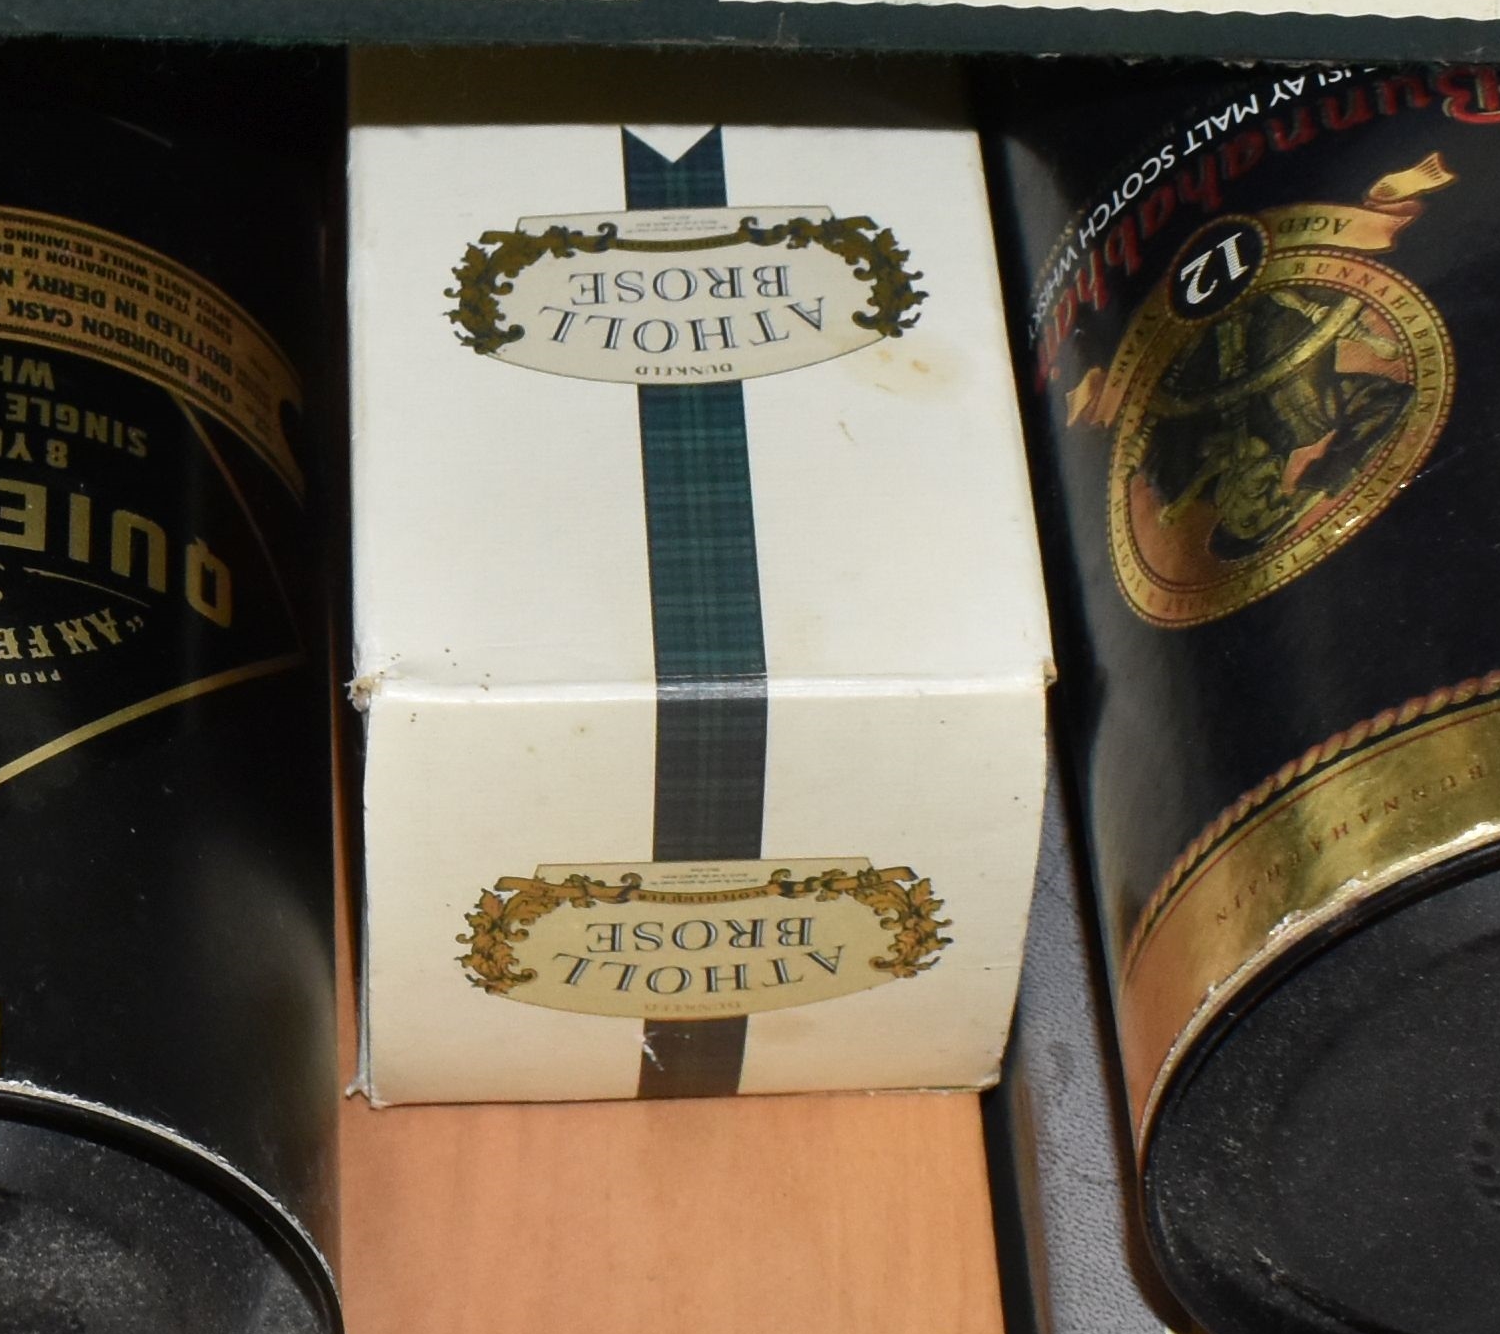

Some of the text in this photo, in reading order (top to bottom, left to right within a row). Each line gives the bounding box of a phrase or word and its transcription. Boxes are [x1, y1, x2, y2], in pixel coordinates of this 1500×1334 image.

[1182, 92, 1261, 156] MALT
[1077, 142, 1177, 247] SCOTCH
[1276, 215, 1353, 237] AGED
[22, 269, 108, 311] DERRY,
[565, 264, 790, 306] BROSE
[1177, 230, 1250, 306] 12
[7, 297, 74, 329] CASK
[113, 296, 139, 323] IN
[537, 296, 826, 355] ATHOLL
[81, 314, 191, 379] BOURBON
[145, 311, 235, 378] BOTTLED
[4, 391, 149, 459] SINGLE
[45, 438, 69, 469] 8
[1213, 763, 1488, 926] BUNNAHAHAIN
[582, 916, 815, 954] BROSE
[551, 944, 845, 996] ATHOLL
